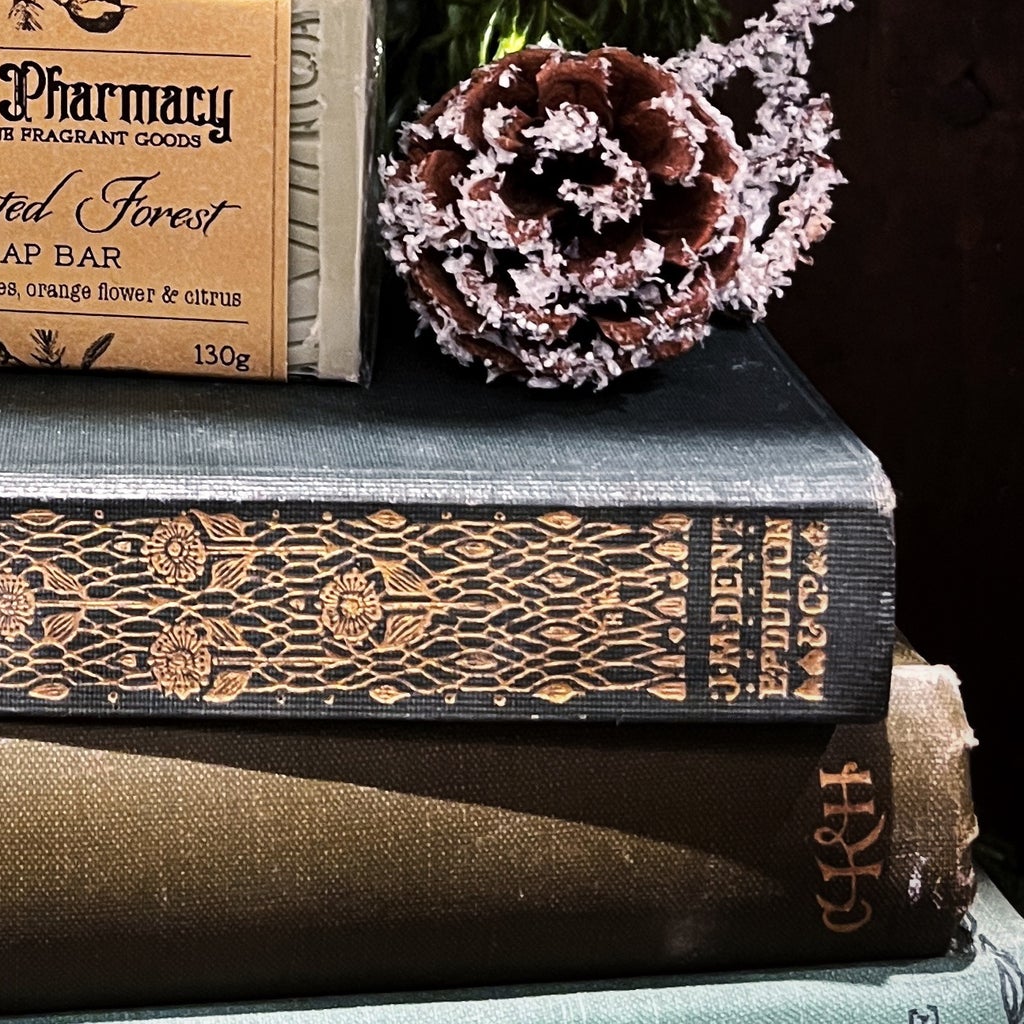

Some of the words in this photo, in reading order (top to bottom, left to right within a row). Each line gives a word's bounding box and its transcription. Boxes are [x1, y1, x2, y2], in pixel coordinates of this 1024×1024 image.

[21, 127, 129, 146] FRAGRANT
[135, 131, 202, 149] GOODS
[76, 171, 242, 237] Forest
[54, 244, 122, 270] BAR
[26, 282, 92, 305] orange
[97, 282, 156, 304] flower
[161, 288, 179, 305] &
[184, 288, 243, 309] citrus
[193, 343, 251, 372] 130g
